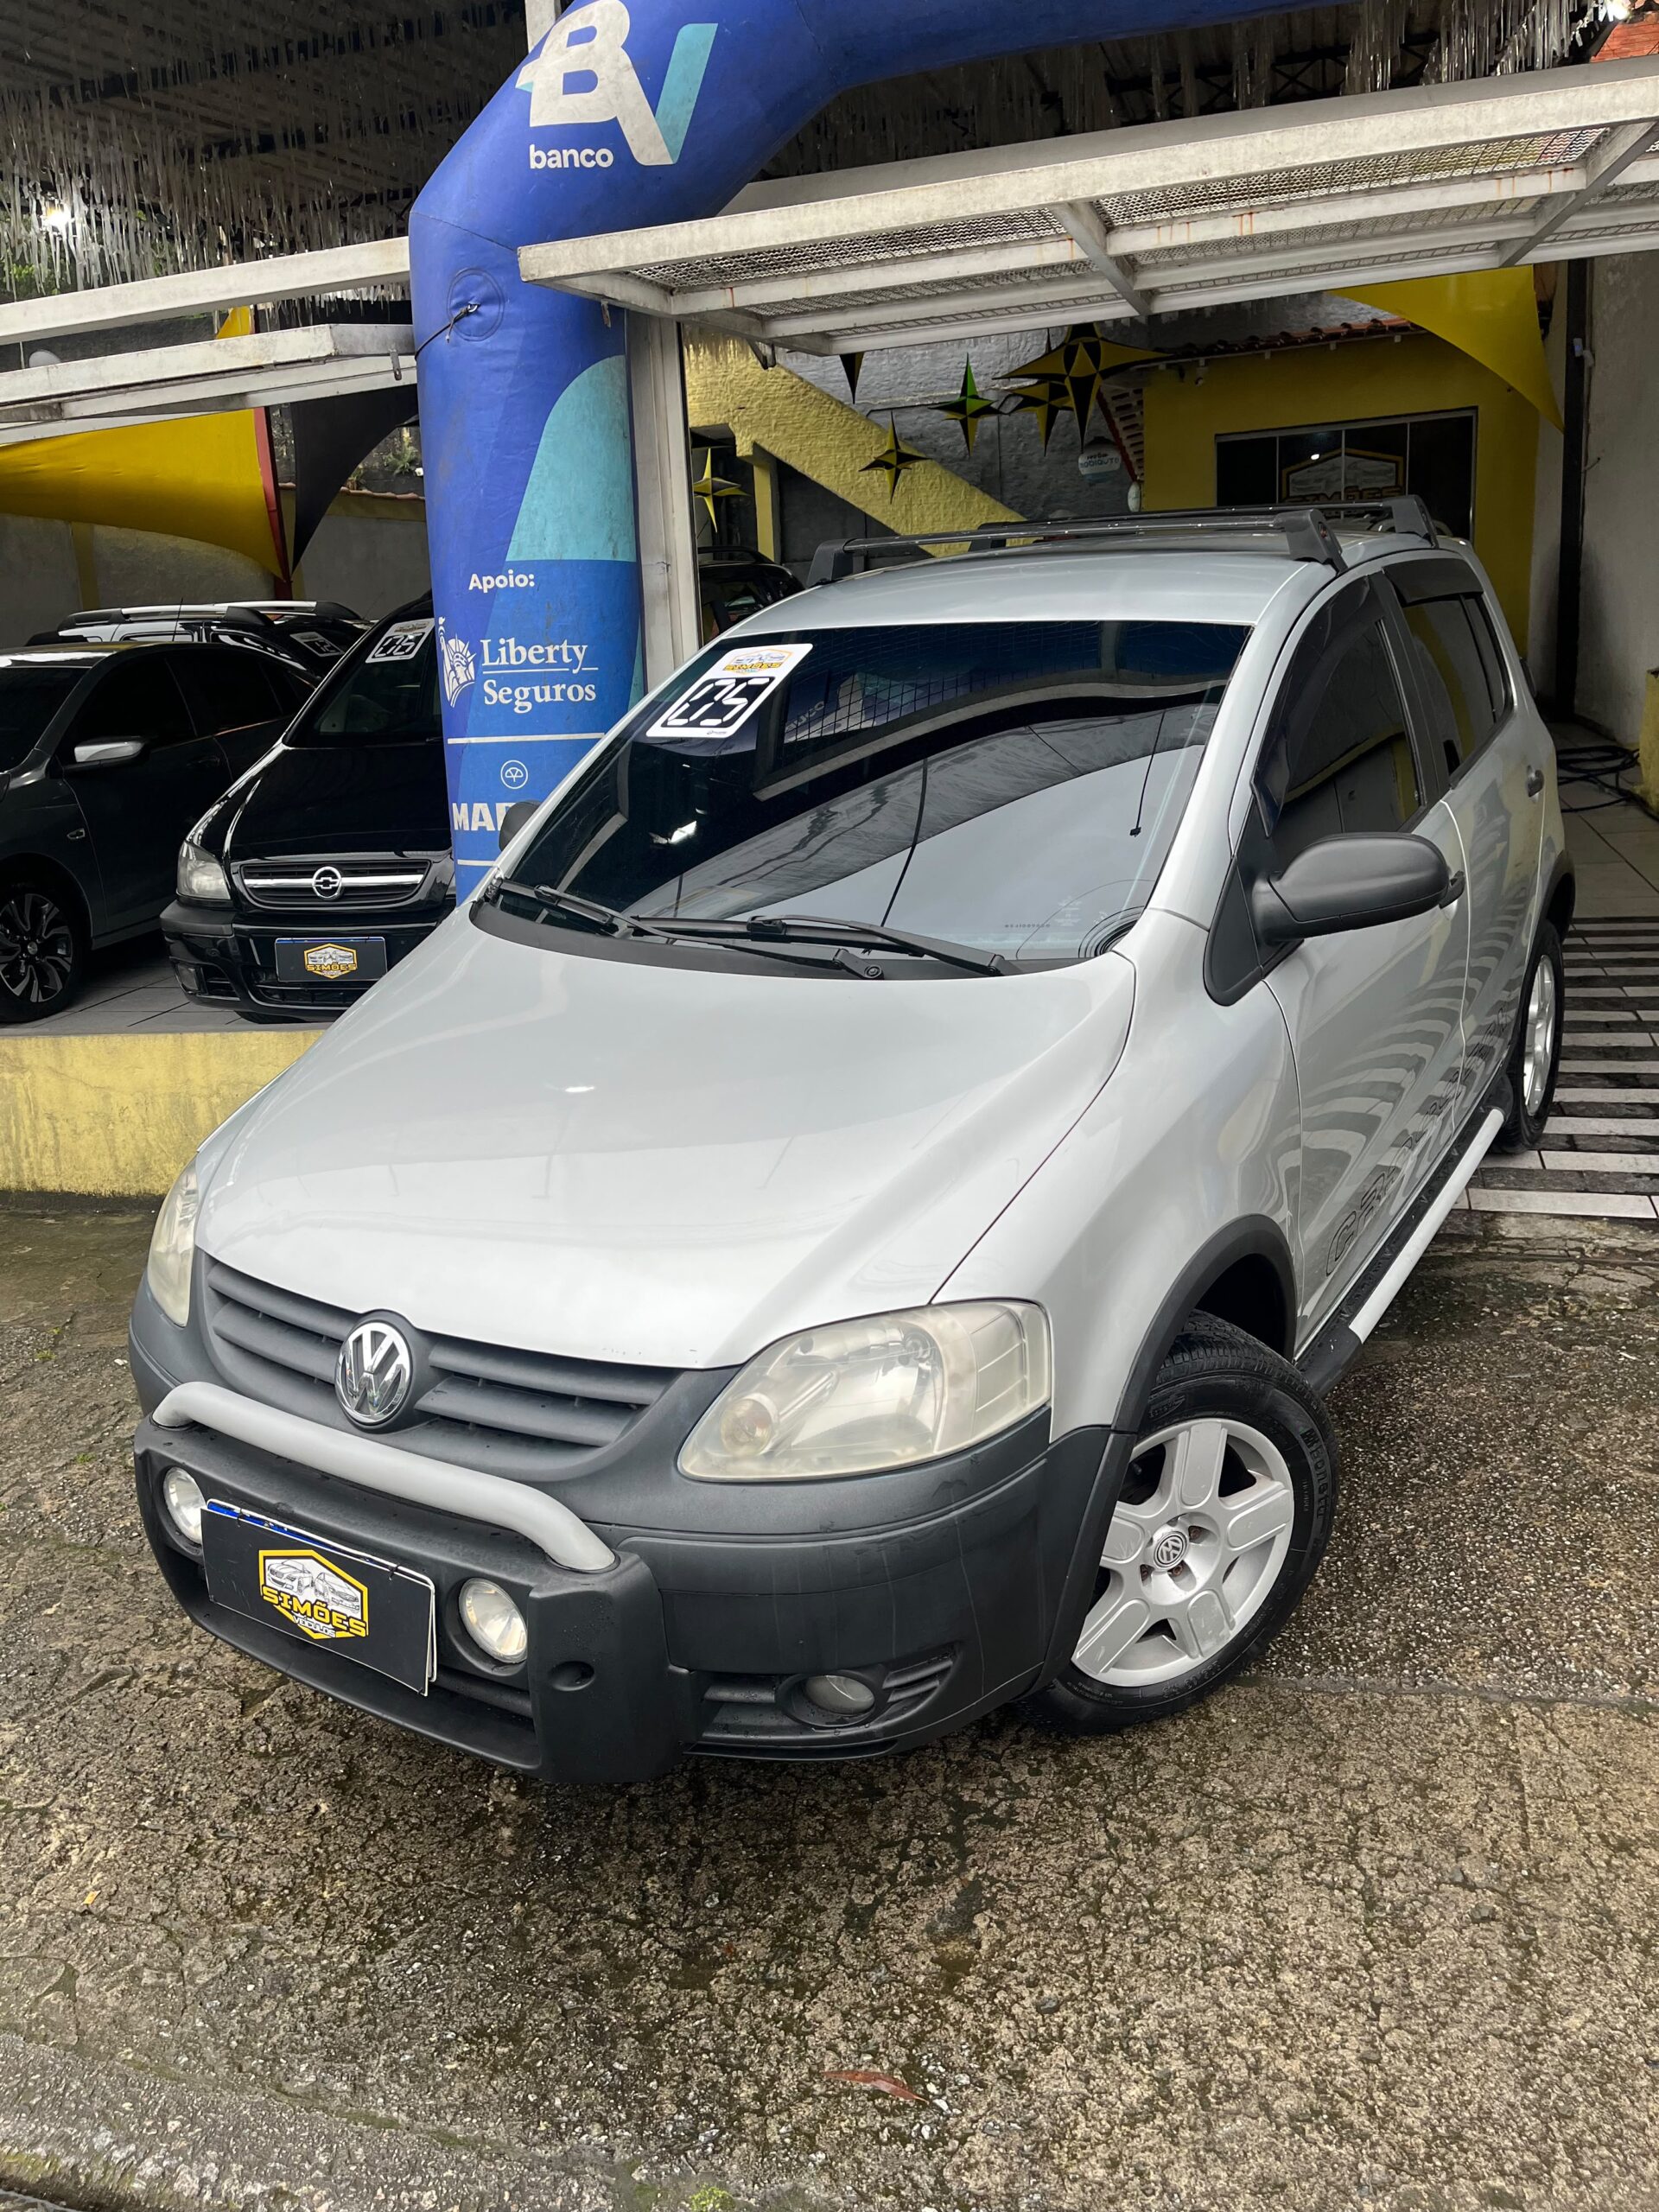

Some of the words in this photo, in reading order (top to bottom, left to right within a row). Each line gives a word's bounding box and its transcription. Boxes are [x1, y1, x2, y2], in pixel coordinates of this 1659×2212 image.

[530, 144, 613, 168] banco
[468, 569, 535, 593] Apoio:
[480, 637, 588, 674] Liberty
[484, 679, 596, 713] Seguros
[667, 677, 770, 726] 05
[263, 1586, 366, 1637] SIMÕES
